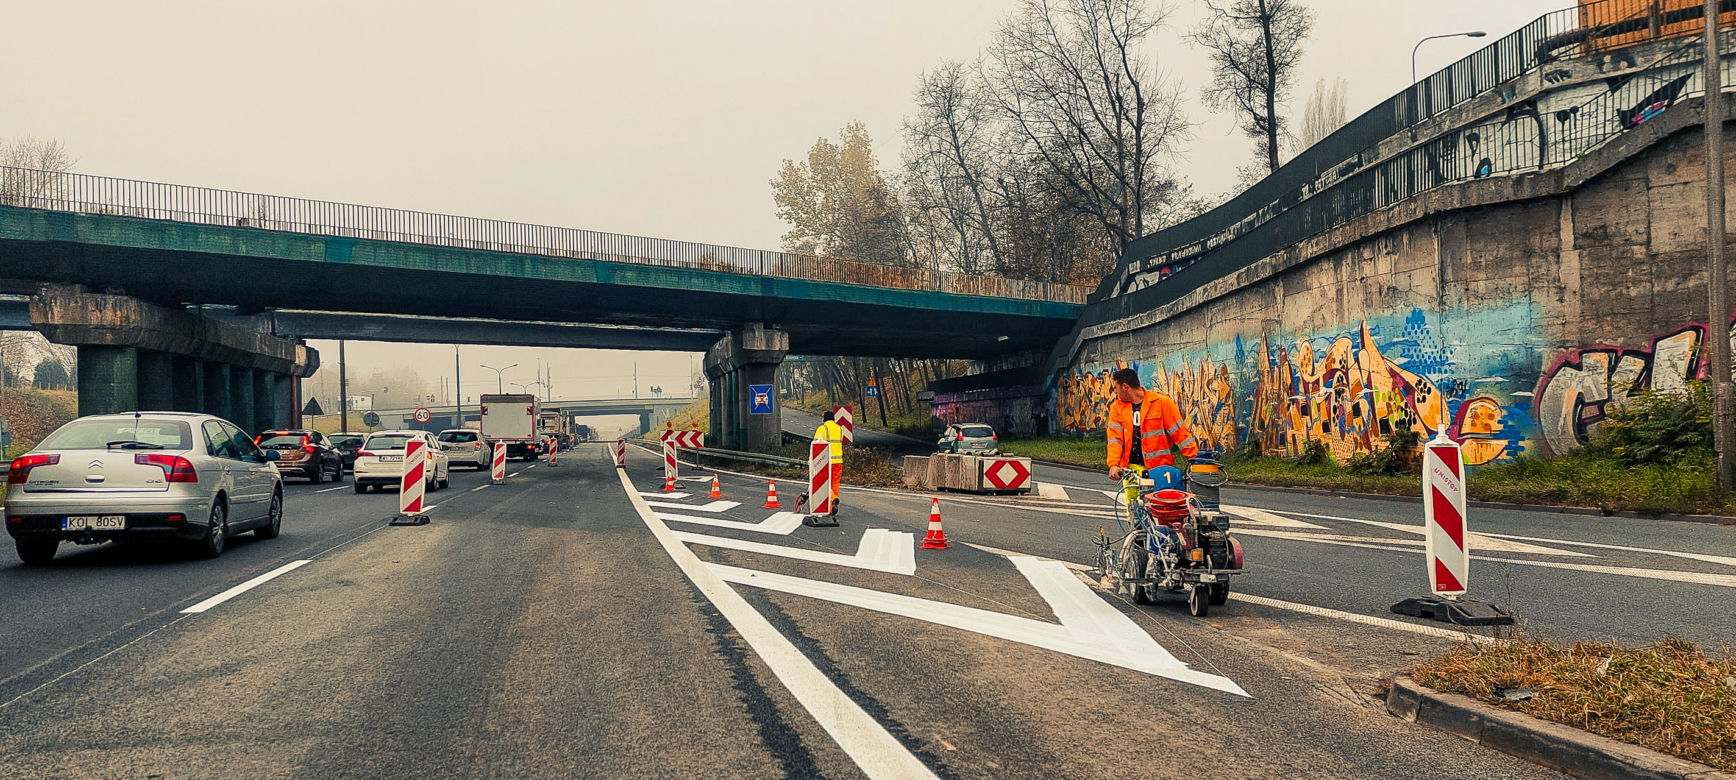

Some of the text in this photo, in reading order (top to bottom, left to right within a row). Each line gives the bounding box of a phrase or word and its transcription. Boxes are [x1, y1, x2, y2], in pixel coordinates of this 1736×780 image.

[1163, 472, 1171, 484] 1
[1434, 467, 1458, 491] UNISTOP
[68, 516, 124, 528] KOL 80SV
